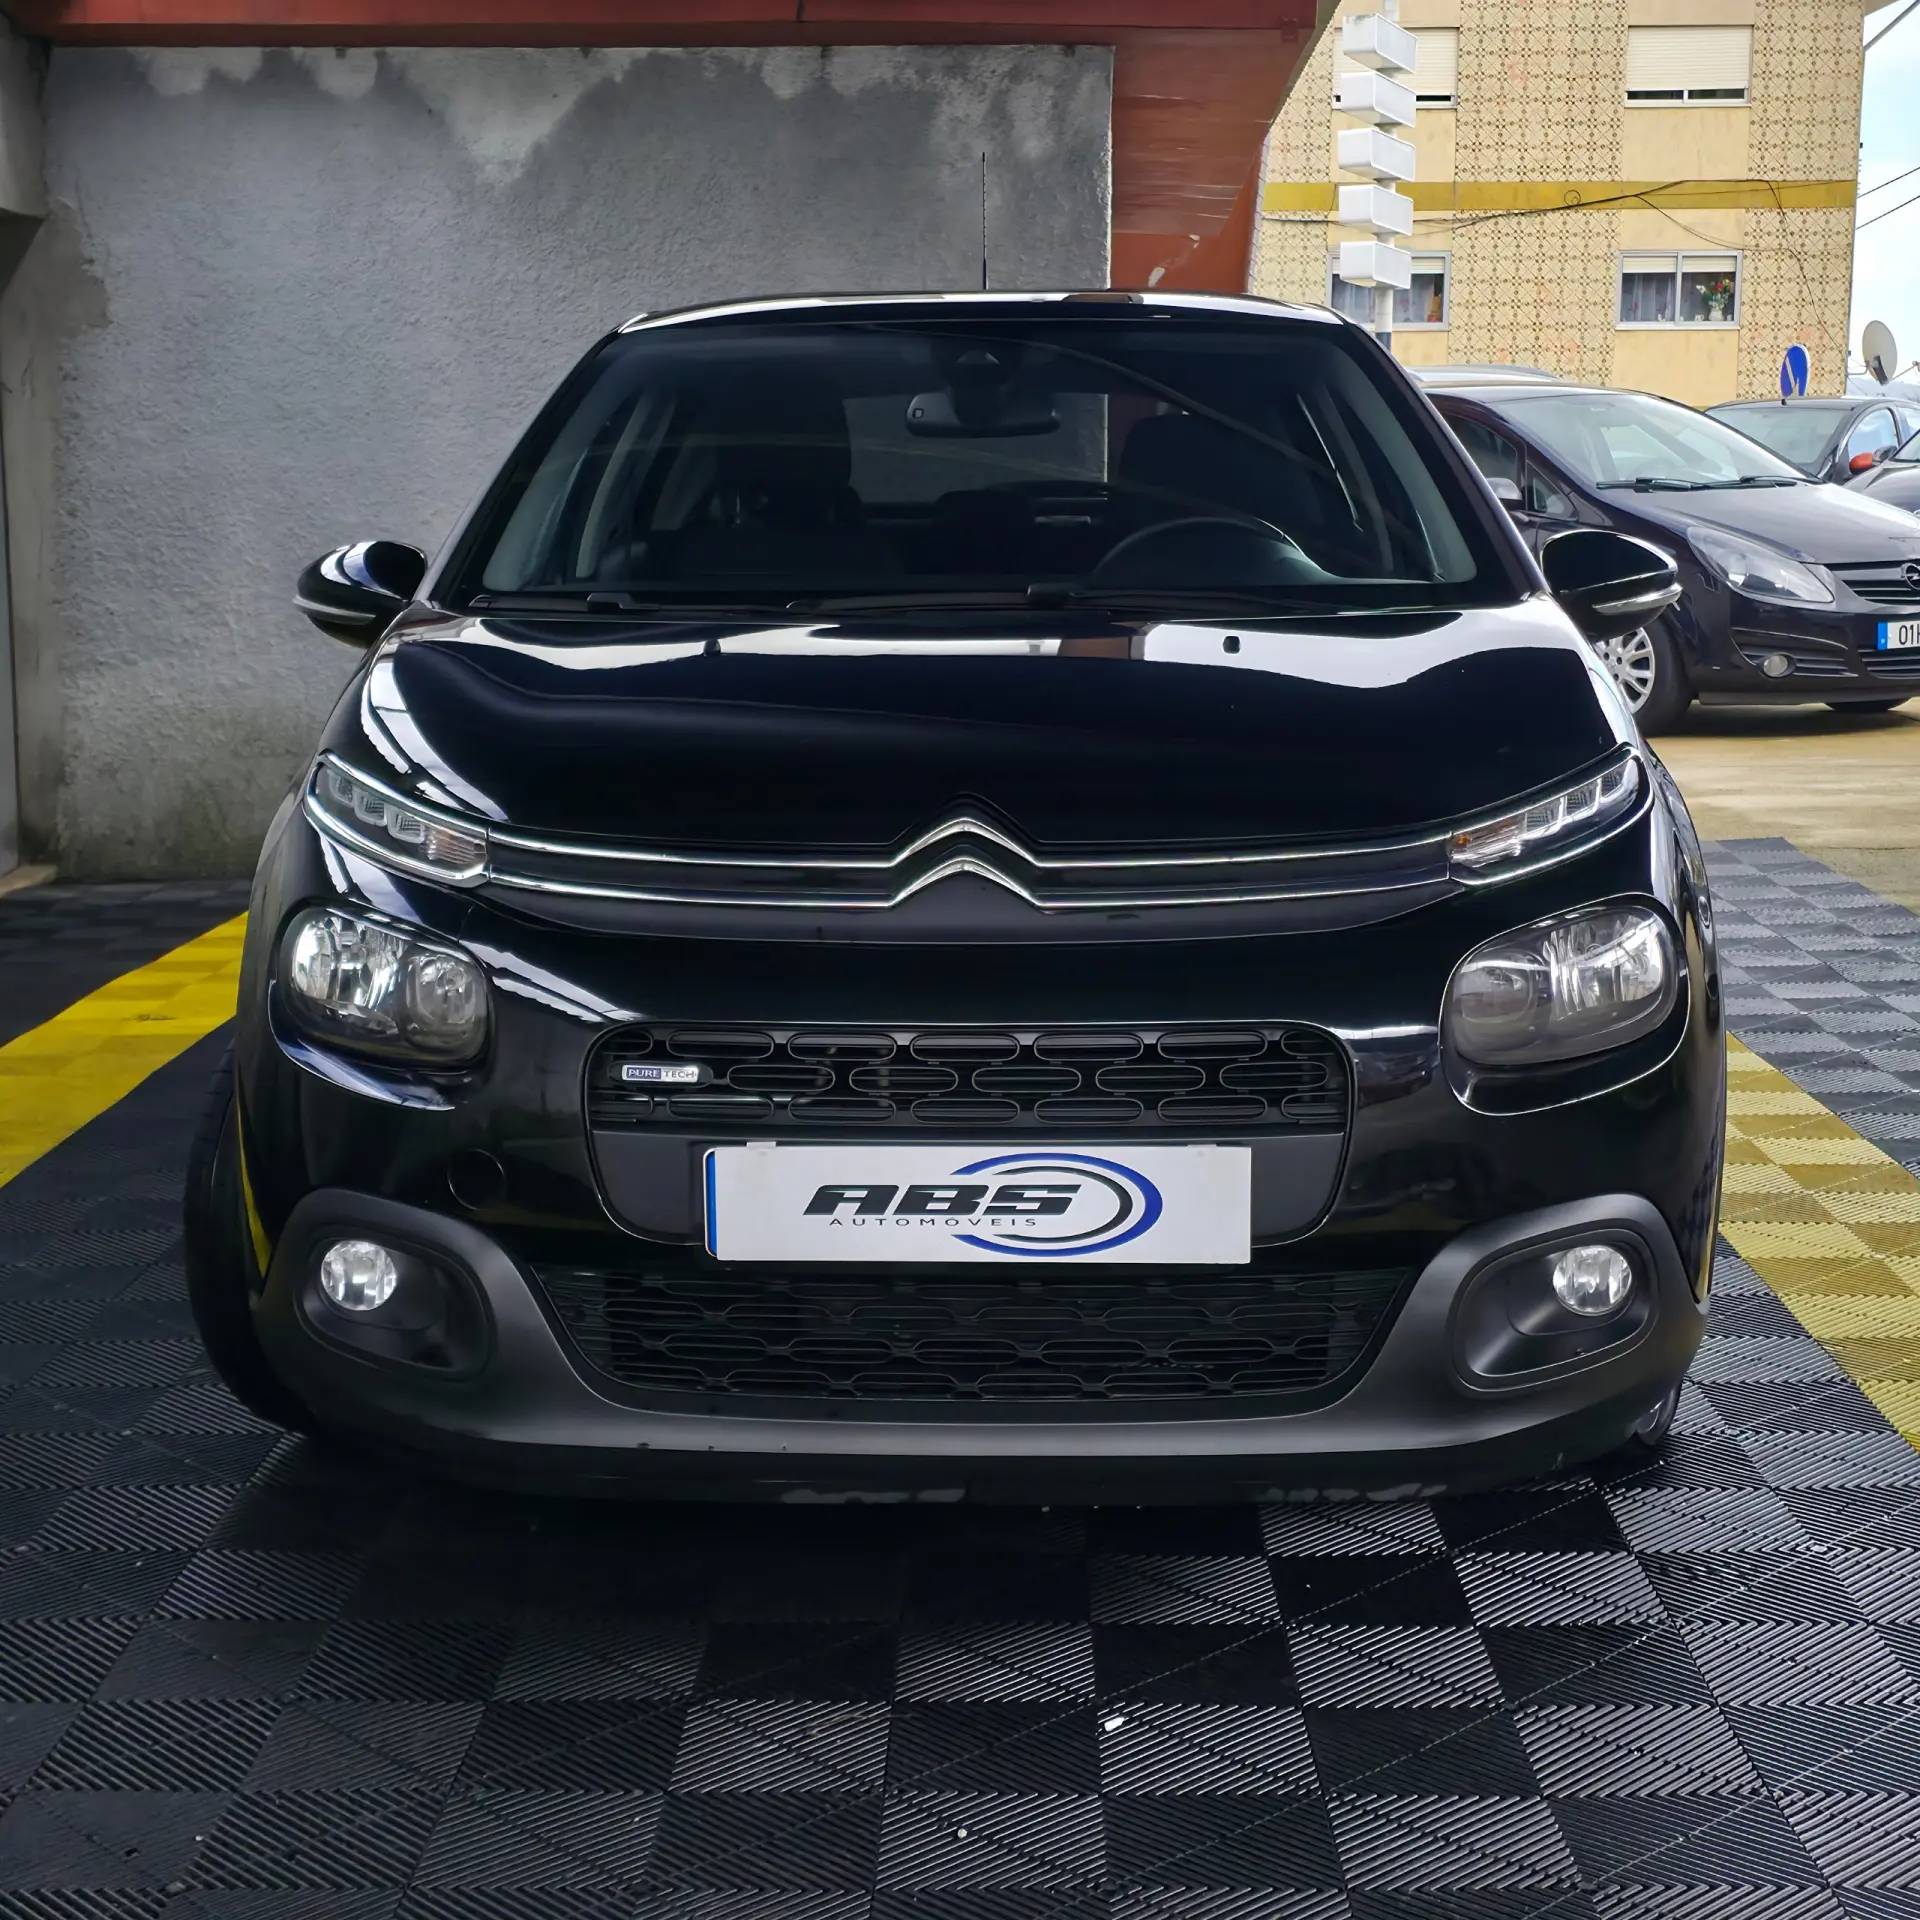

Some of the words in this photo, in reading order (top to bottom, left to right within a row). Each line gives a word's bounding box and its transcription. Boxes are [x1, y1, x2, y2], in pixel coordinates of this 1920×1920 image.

[628, 1068, 660, 1078] PURE
[663, 1070, 695, 1079] TECH
[803, 1184, 1082, 1215] ABS
[829, 1217, 1037, 1226] AUTOMÓVEIS
